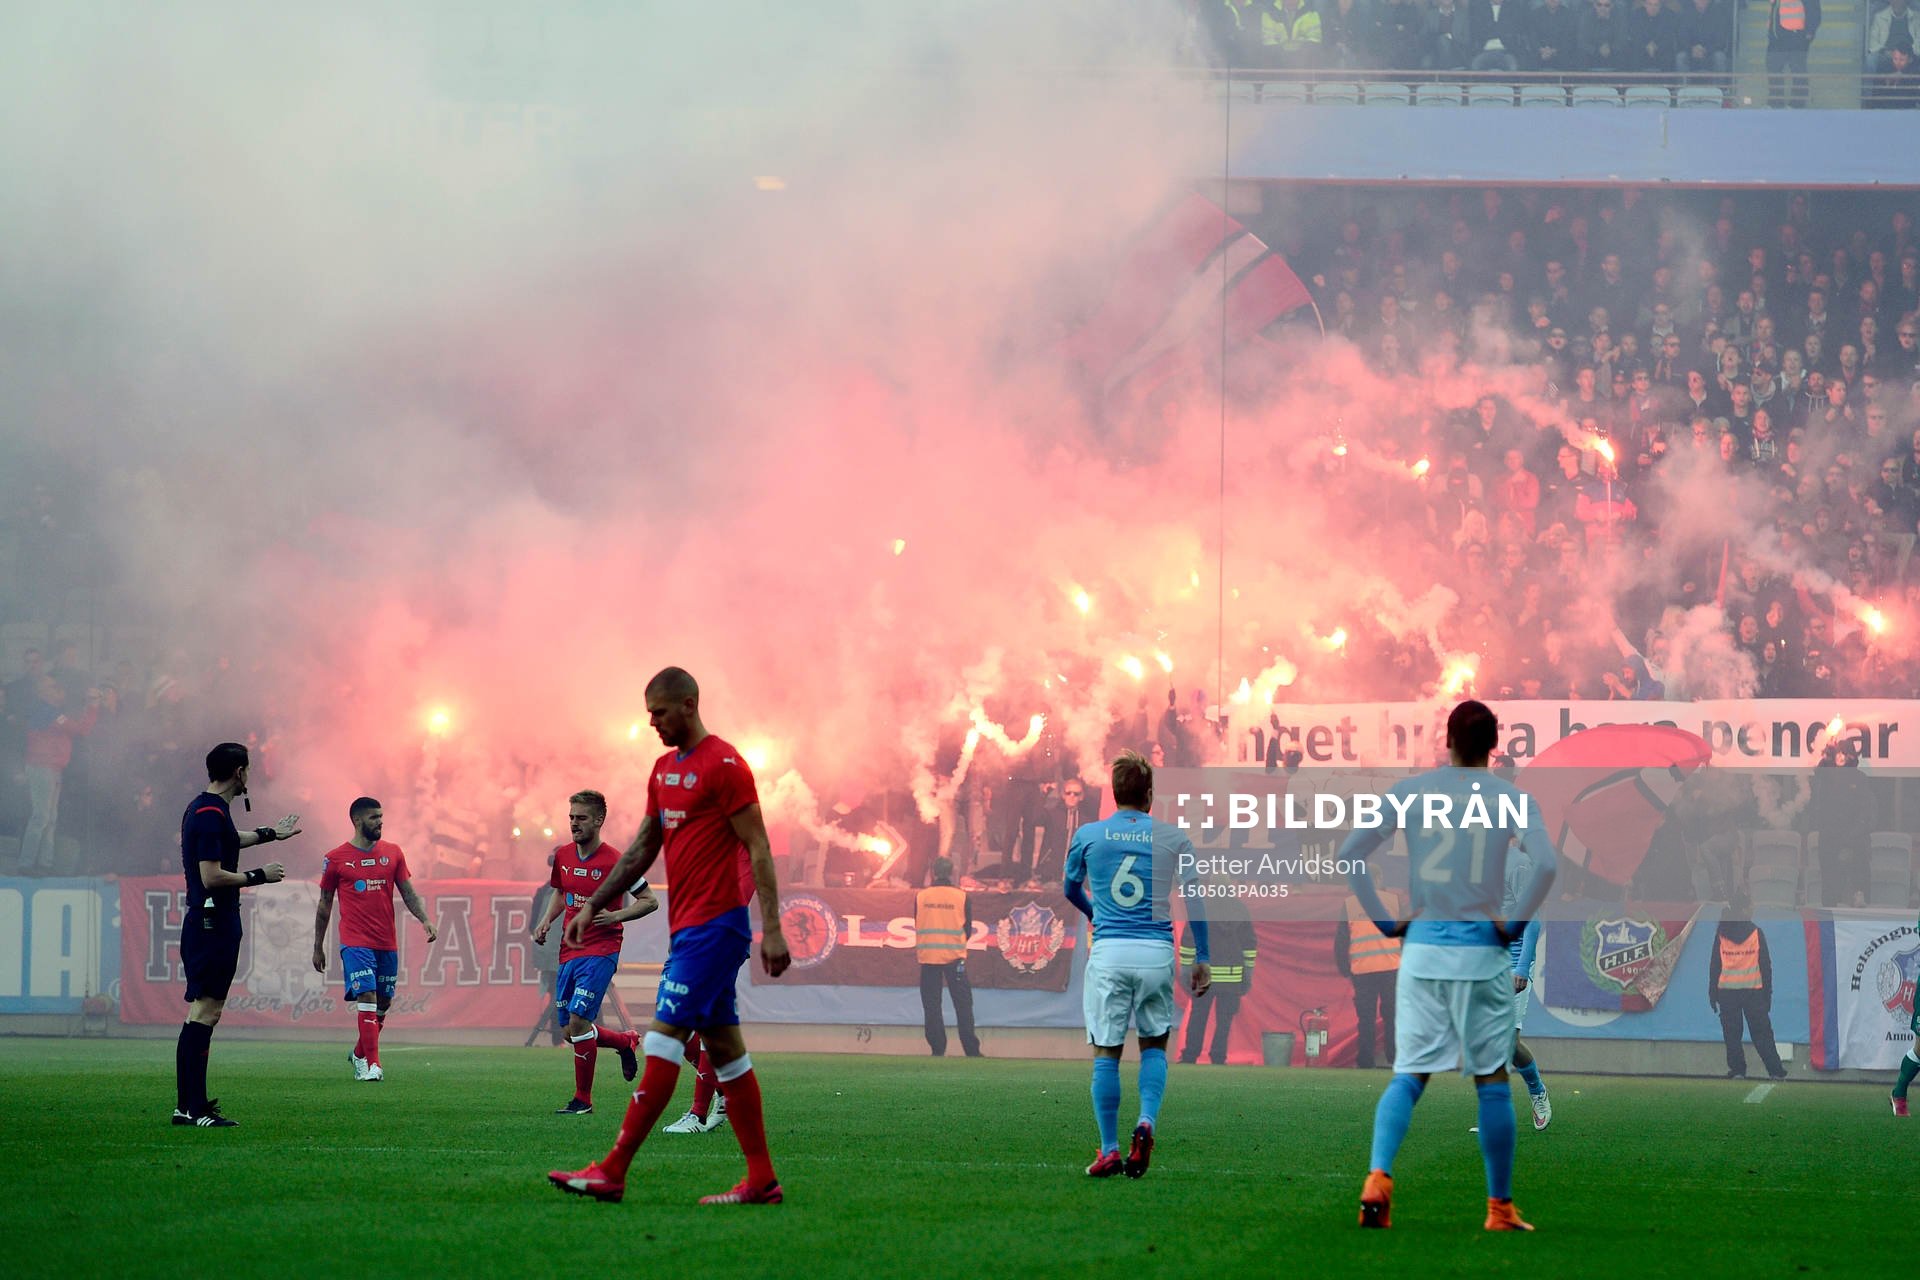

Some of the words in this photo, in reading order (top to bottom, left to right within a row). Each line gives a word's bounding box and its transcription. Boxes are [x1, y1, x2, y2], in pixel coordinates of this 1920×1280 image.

[1420, 819, 1487, 884] 21
[1111, 855, 1145, 908] 6
[1885, 1031, 1914, 1042] Anno
